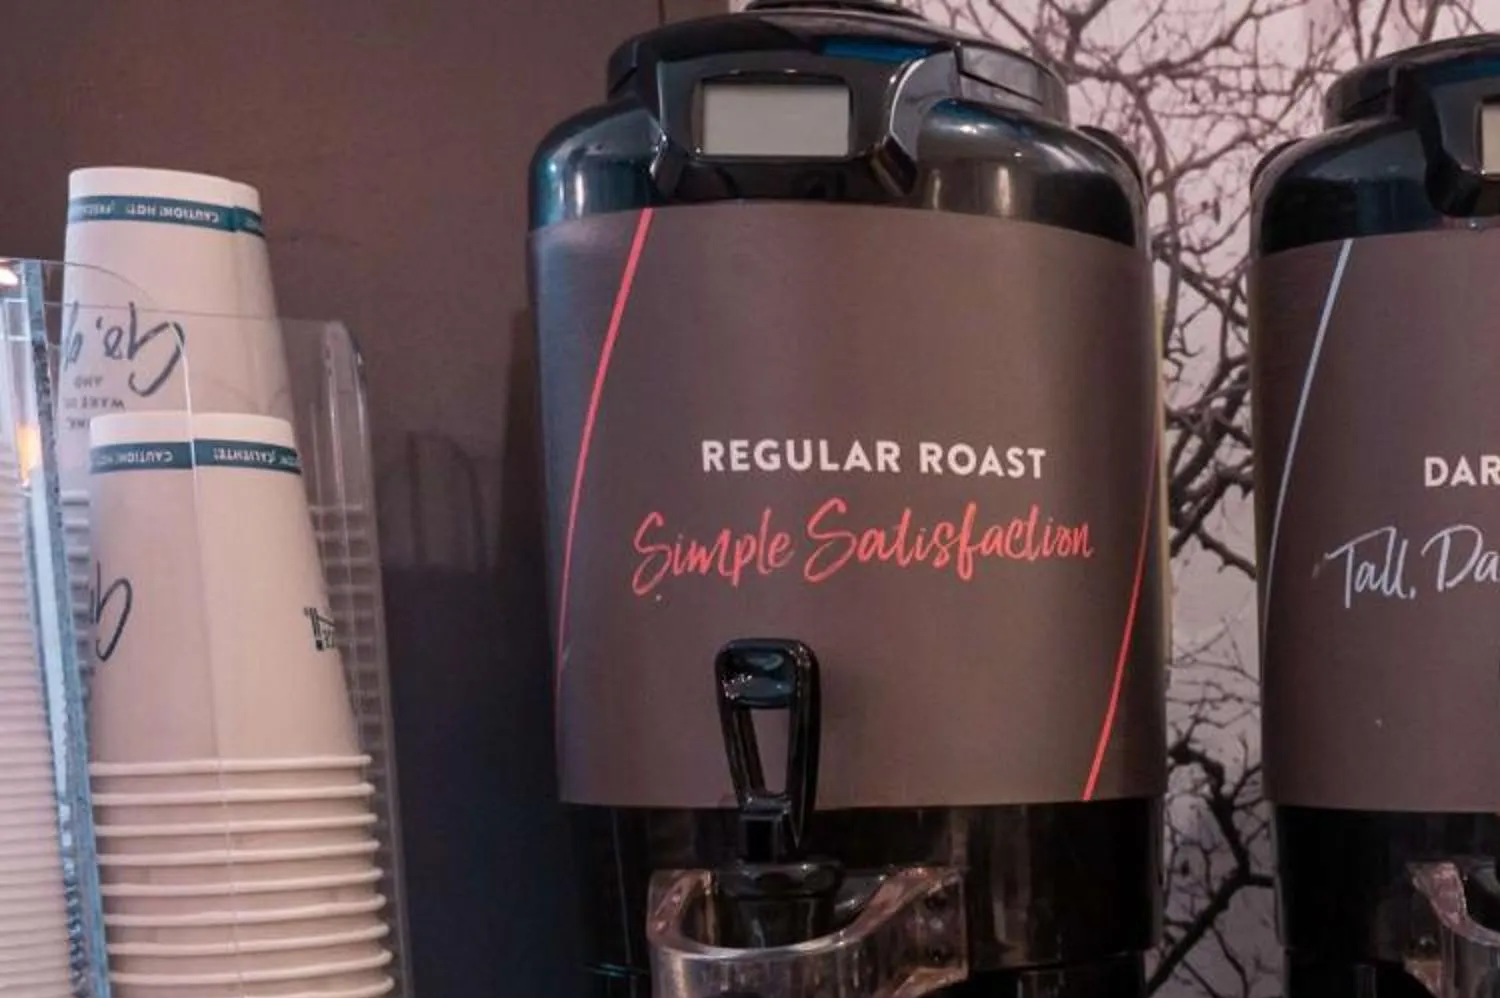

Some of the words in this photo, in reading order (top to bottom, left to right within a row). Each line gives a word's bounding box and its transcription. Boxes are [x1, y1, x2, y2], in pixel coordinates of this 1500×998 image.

[701, 439, 901, 473] REGULAR
[919, 442, 1046, 479] ROAST
[632, 507, 794, 596] Simple
[803, 497, 1094, 583] Satisfaction
